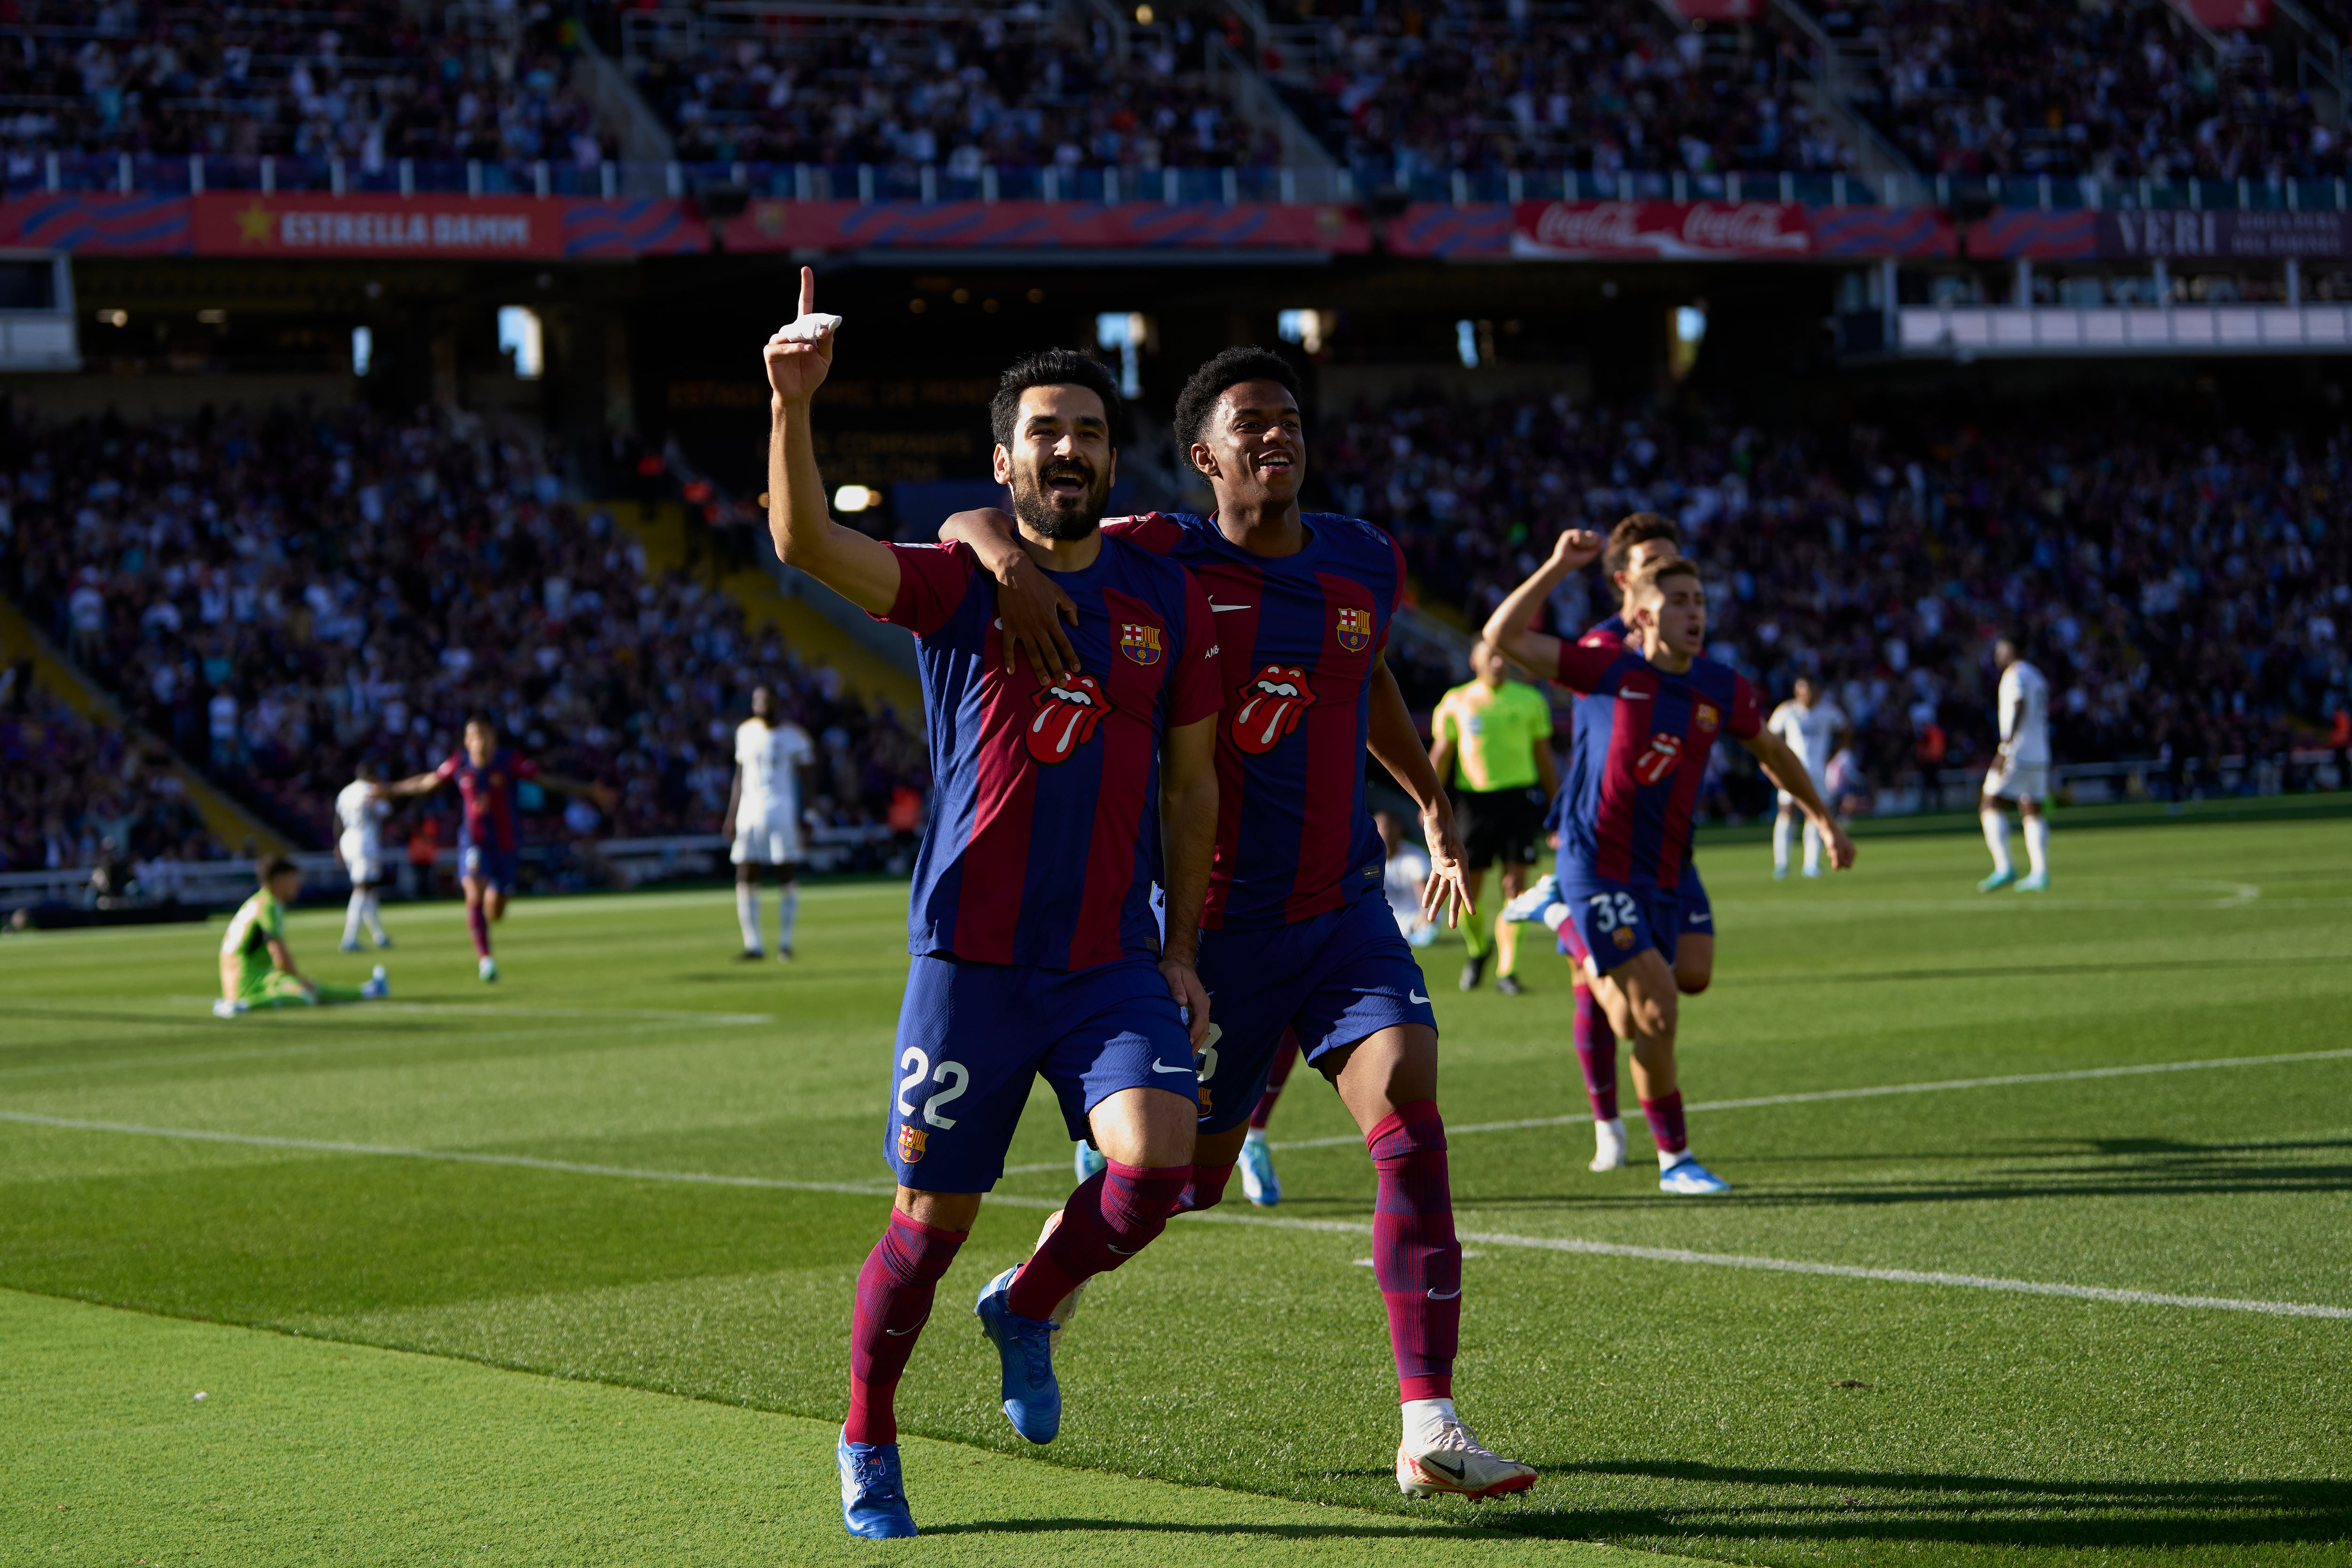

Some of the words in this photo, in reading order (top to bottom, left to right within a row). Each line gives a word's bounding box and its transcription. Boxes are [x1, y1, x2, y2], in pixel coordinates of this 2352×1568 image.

[282, 213, 428, 246] ESTRELLA
[432, 213, 529, 247] DAMM
[2118, 210, 2216, 255] VERI
[1589, 891, 1639, 933] 32
[898, 1046, 969, 1130] 22
